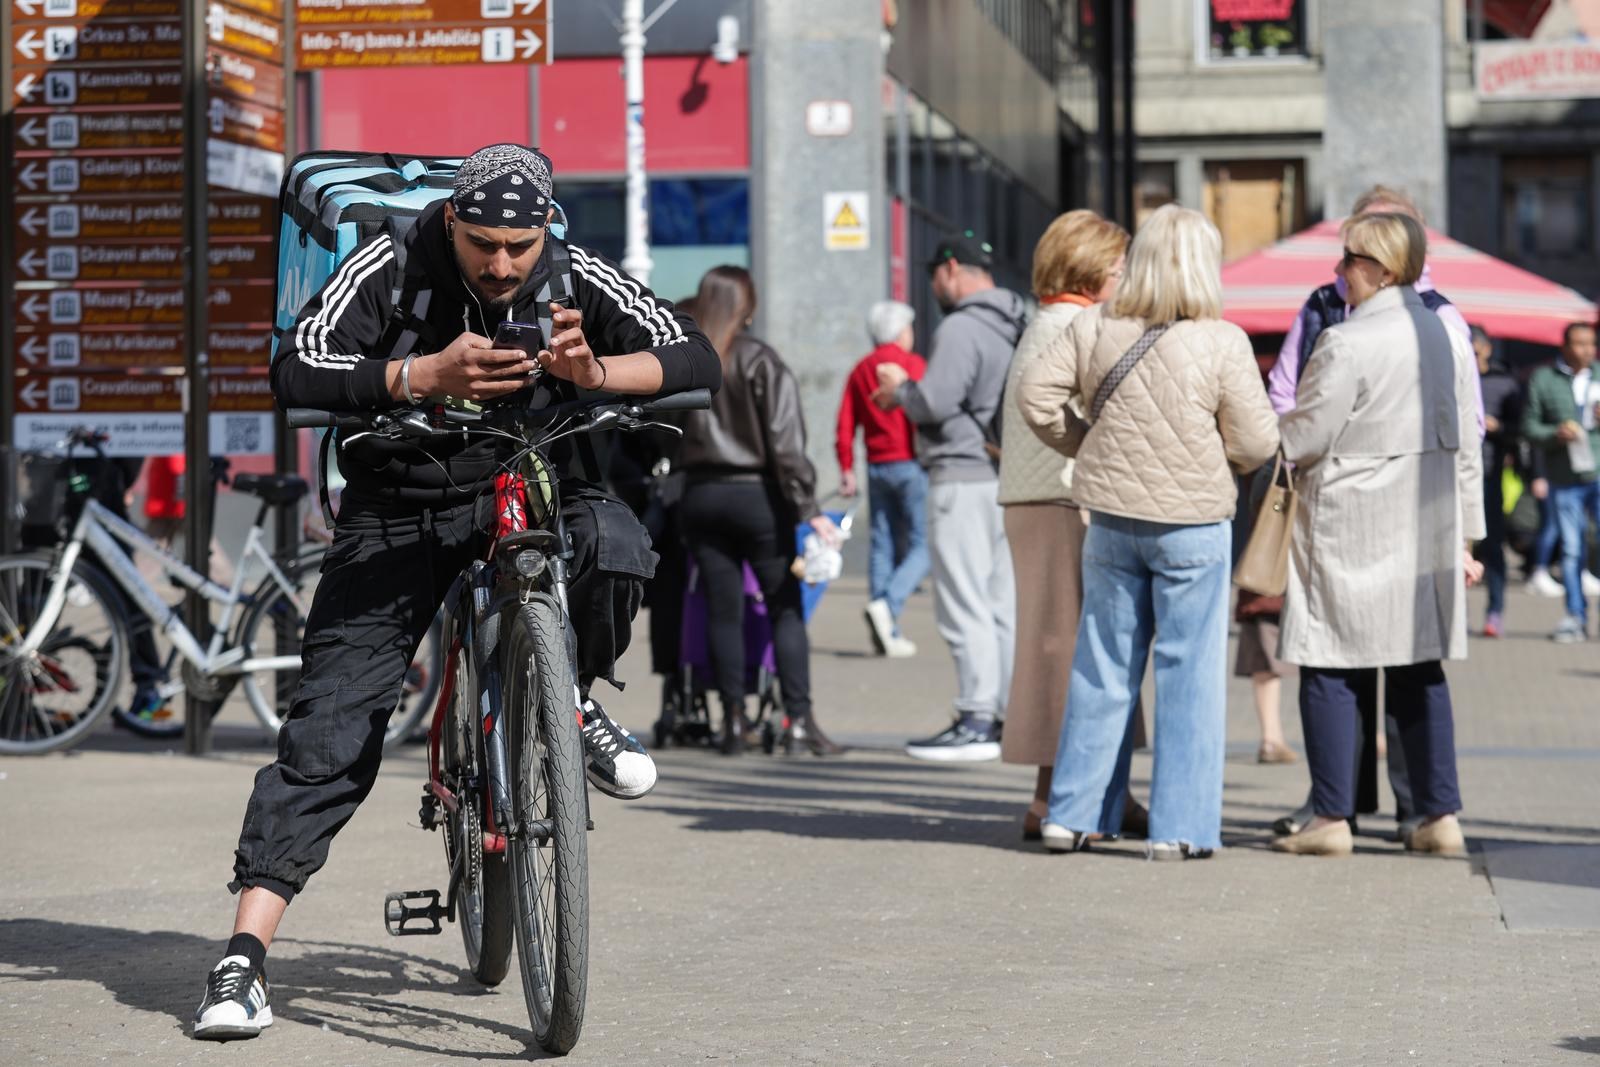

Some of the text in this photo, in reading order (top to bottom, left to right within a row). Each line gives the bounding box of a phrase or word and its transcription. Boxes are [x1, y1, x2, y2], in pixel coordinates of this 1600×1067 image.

[79, 26, 125, 43] Crkva
[79, 71, 182, 87] Kamenita vra
[81, 157, 184, 176] Galerija Klovi
[81, 204, 132, 223] Muzej
[83, 290, 131, 310] Muzej
[141, 420, 184, 432] inform
